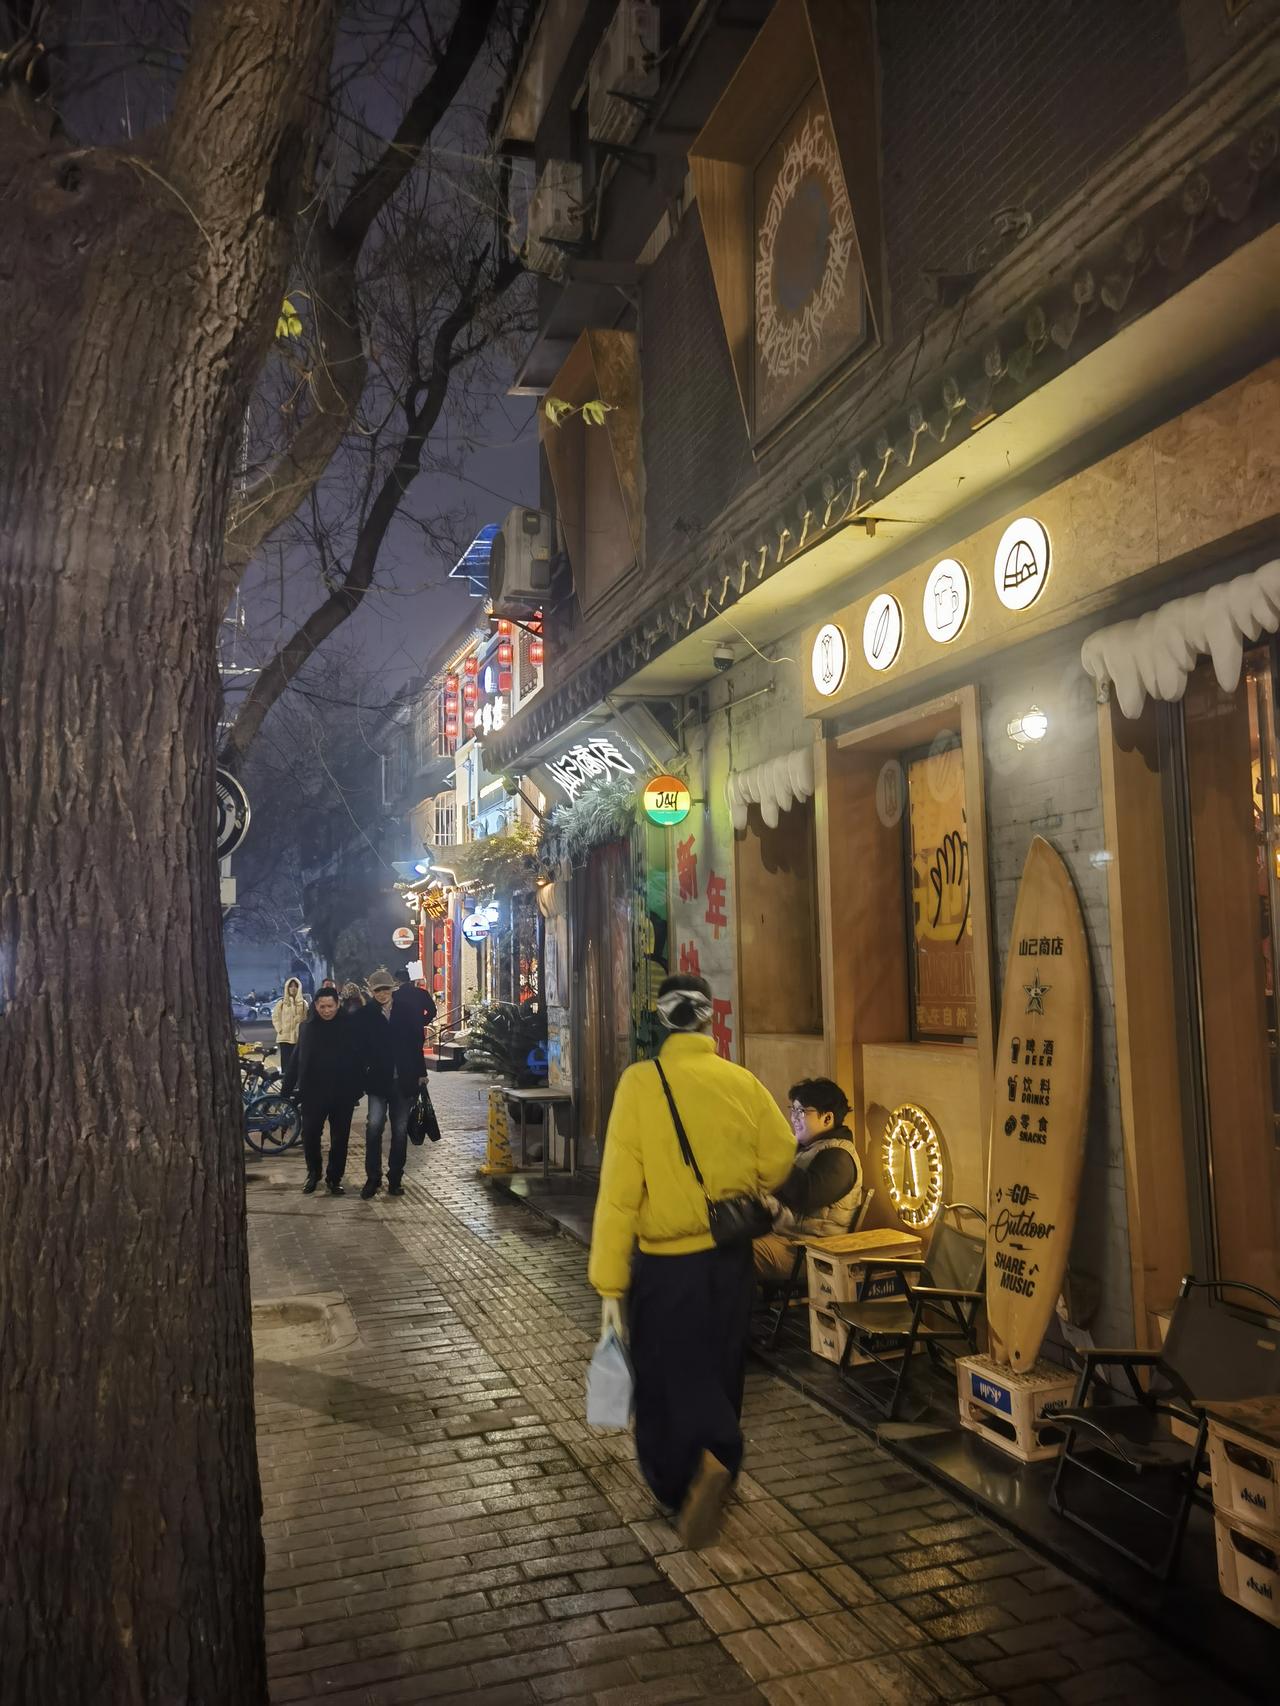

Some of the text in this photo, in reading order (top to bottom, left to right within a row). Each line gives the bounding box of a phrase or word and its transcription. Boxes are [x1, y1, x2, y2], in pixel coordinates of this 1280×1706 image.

[1025, 1055, 1053, 1067] BEER
[1023, 1076, 1051, 1095] 饮料
[1021, 1092, 1050, 1106] DRINKS
[1018, 1130, 1048, 1145] SNACKS
[1011, 1183, 1029, 1206] GO
[989, 1208, 1056, 1243] Outdoor
[994, 1251, 1026, 1276] SHARE
[1000, 1271, 1036, 1298] MUSIC
[1240, 1488, 1266, 1509] Asahi
[1247, 1576, 1272, 1597] Asahi
